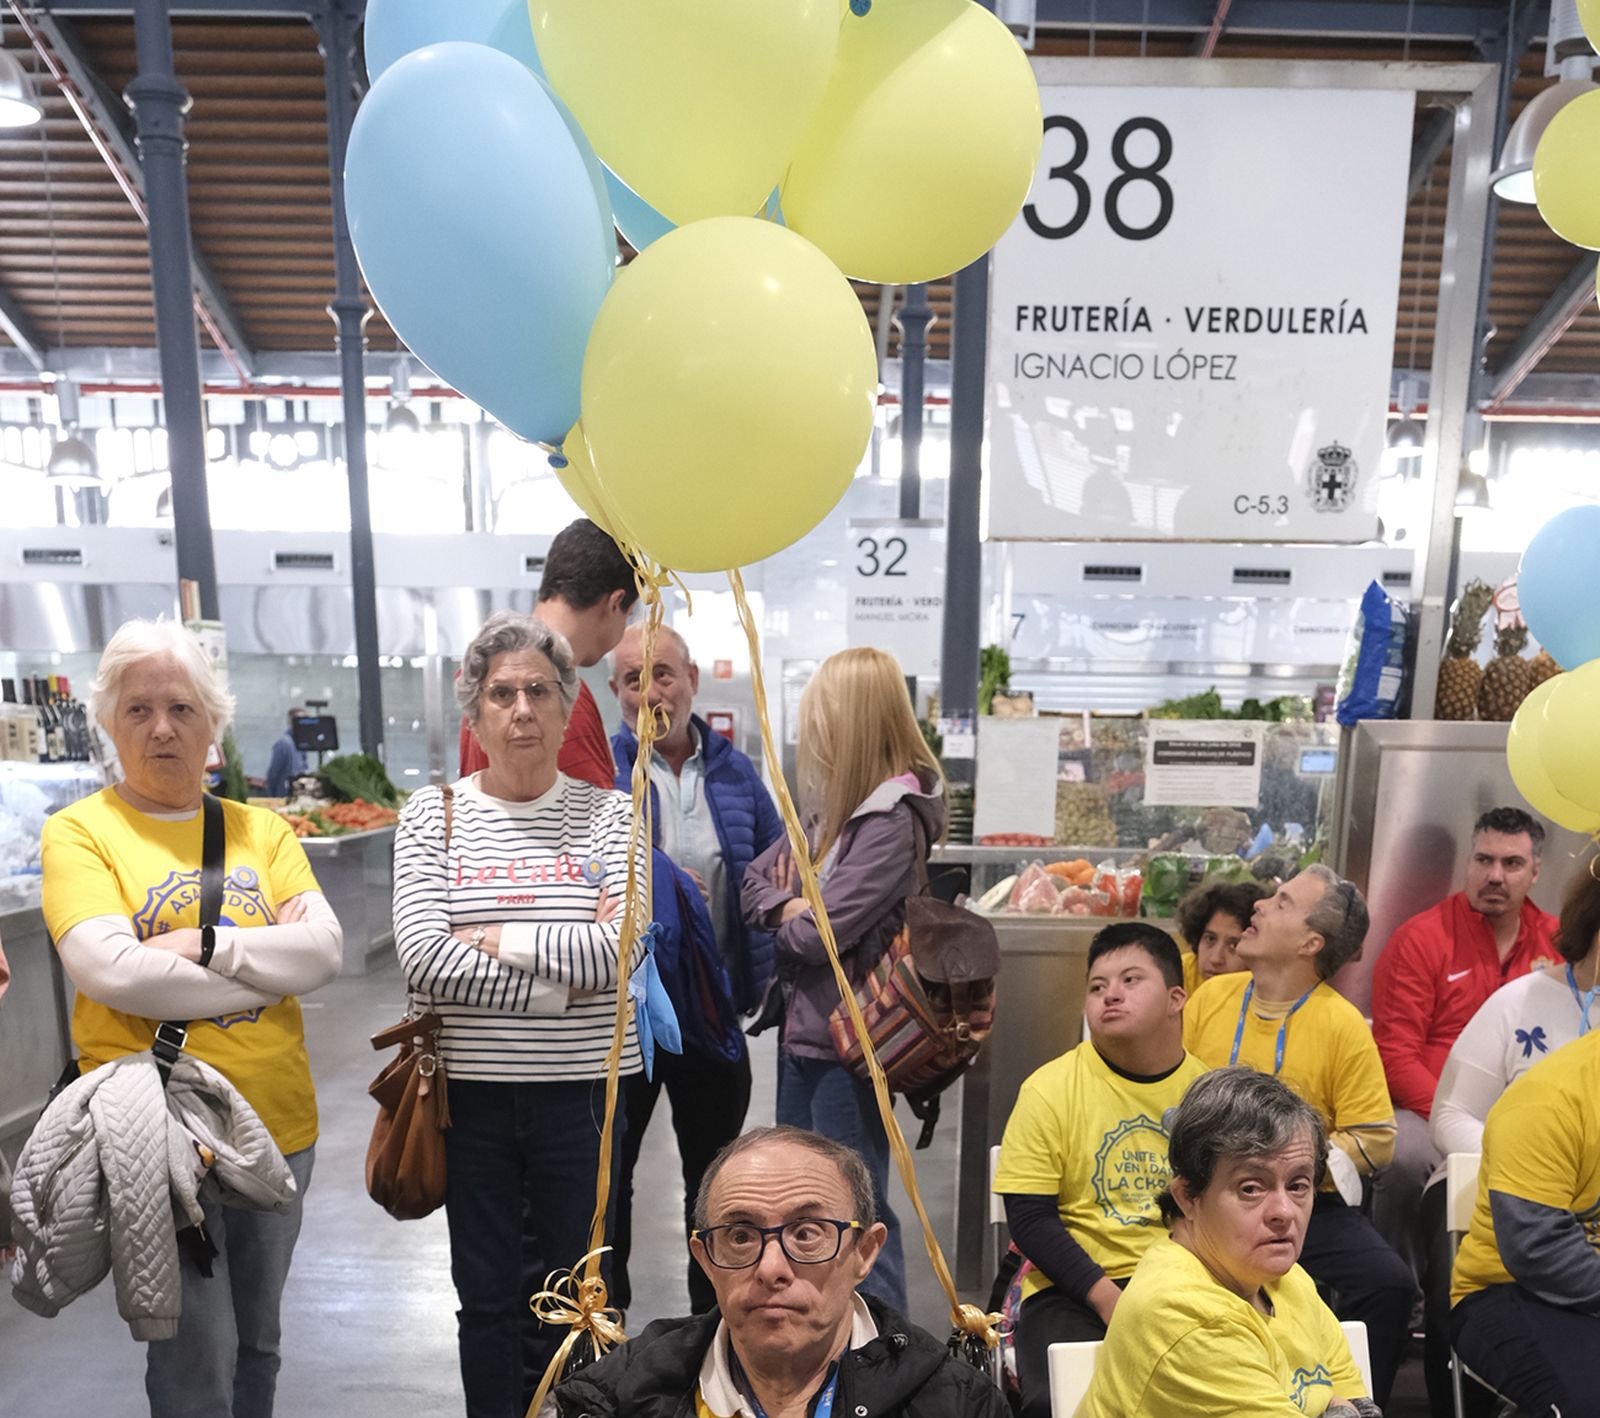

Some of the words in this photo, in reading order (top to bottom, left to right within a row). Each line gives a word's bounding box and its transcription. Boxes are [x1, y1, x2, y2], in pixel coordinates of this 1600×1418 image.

[1022, 115, 1174, 241] 38
[1016, 297, 1152, 333] FRUTERÍA
[1185, 299, 1368, 334] VERDULERÍA
[1014, 352, 1144, 380] IGNACIO
[1153, 348, 1237, 381] LÓPEZ
[1234, 495, 1289, 515] C-5.3
[856, 537, 908, 577] 32
[914, 596, 944, 607] VERD
[1108, 1177, 1129, 1191] LA
